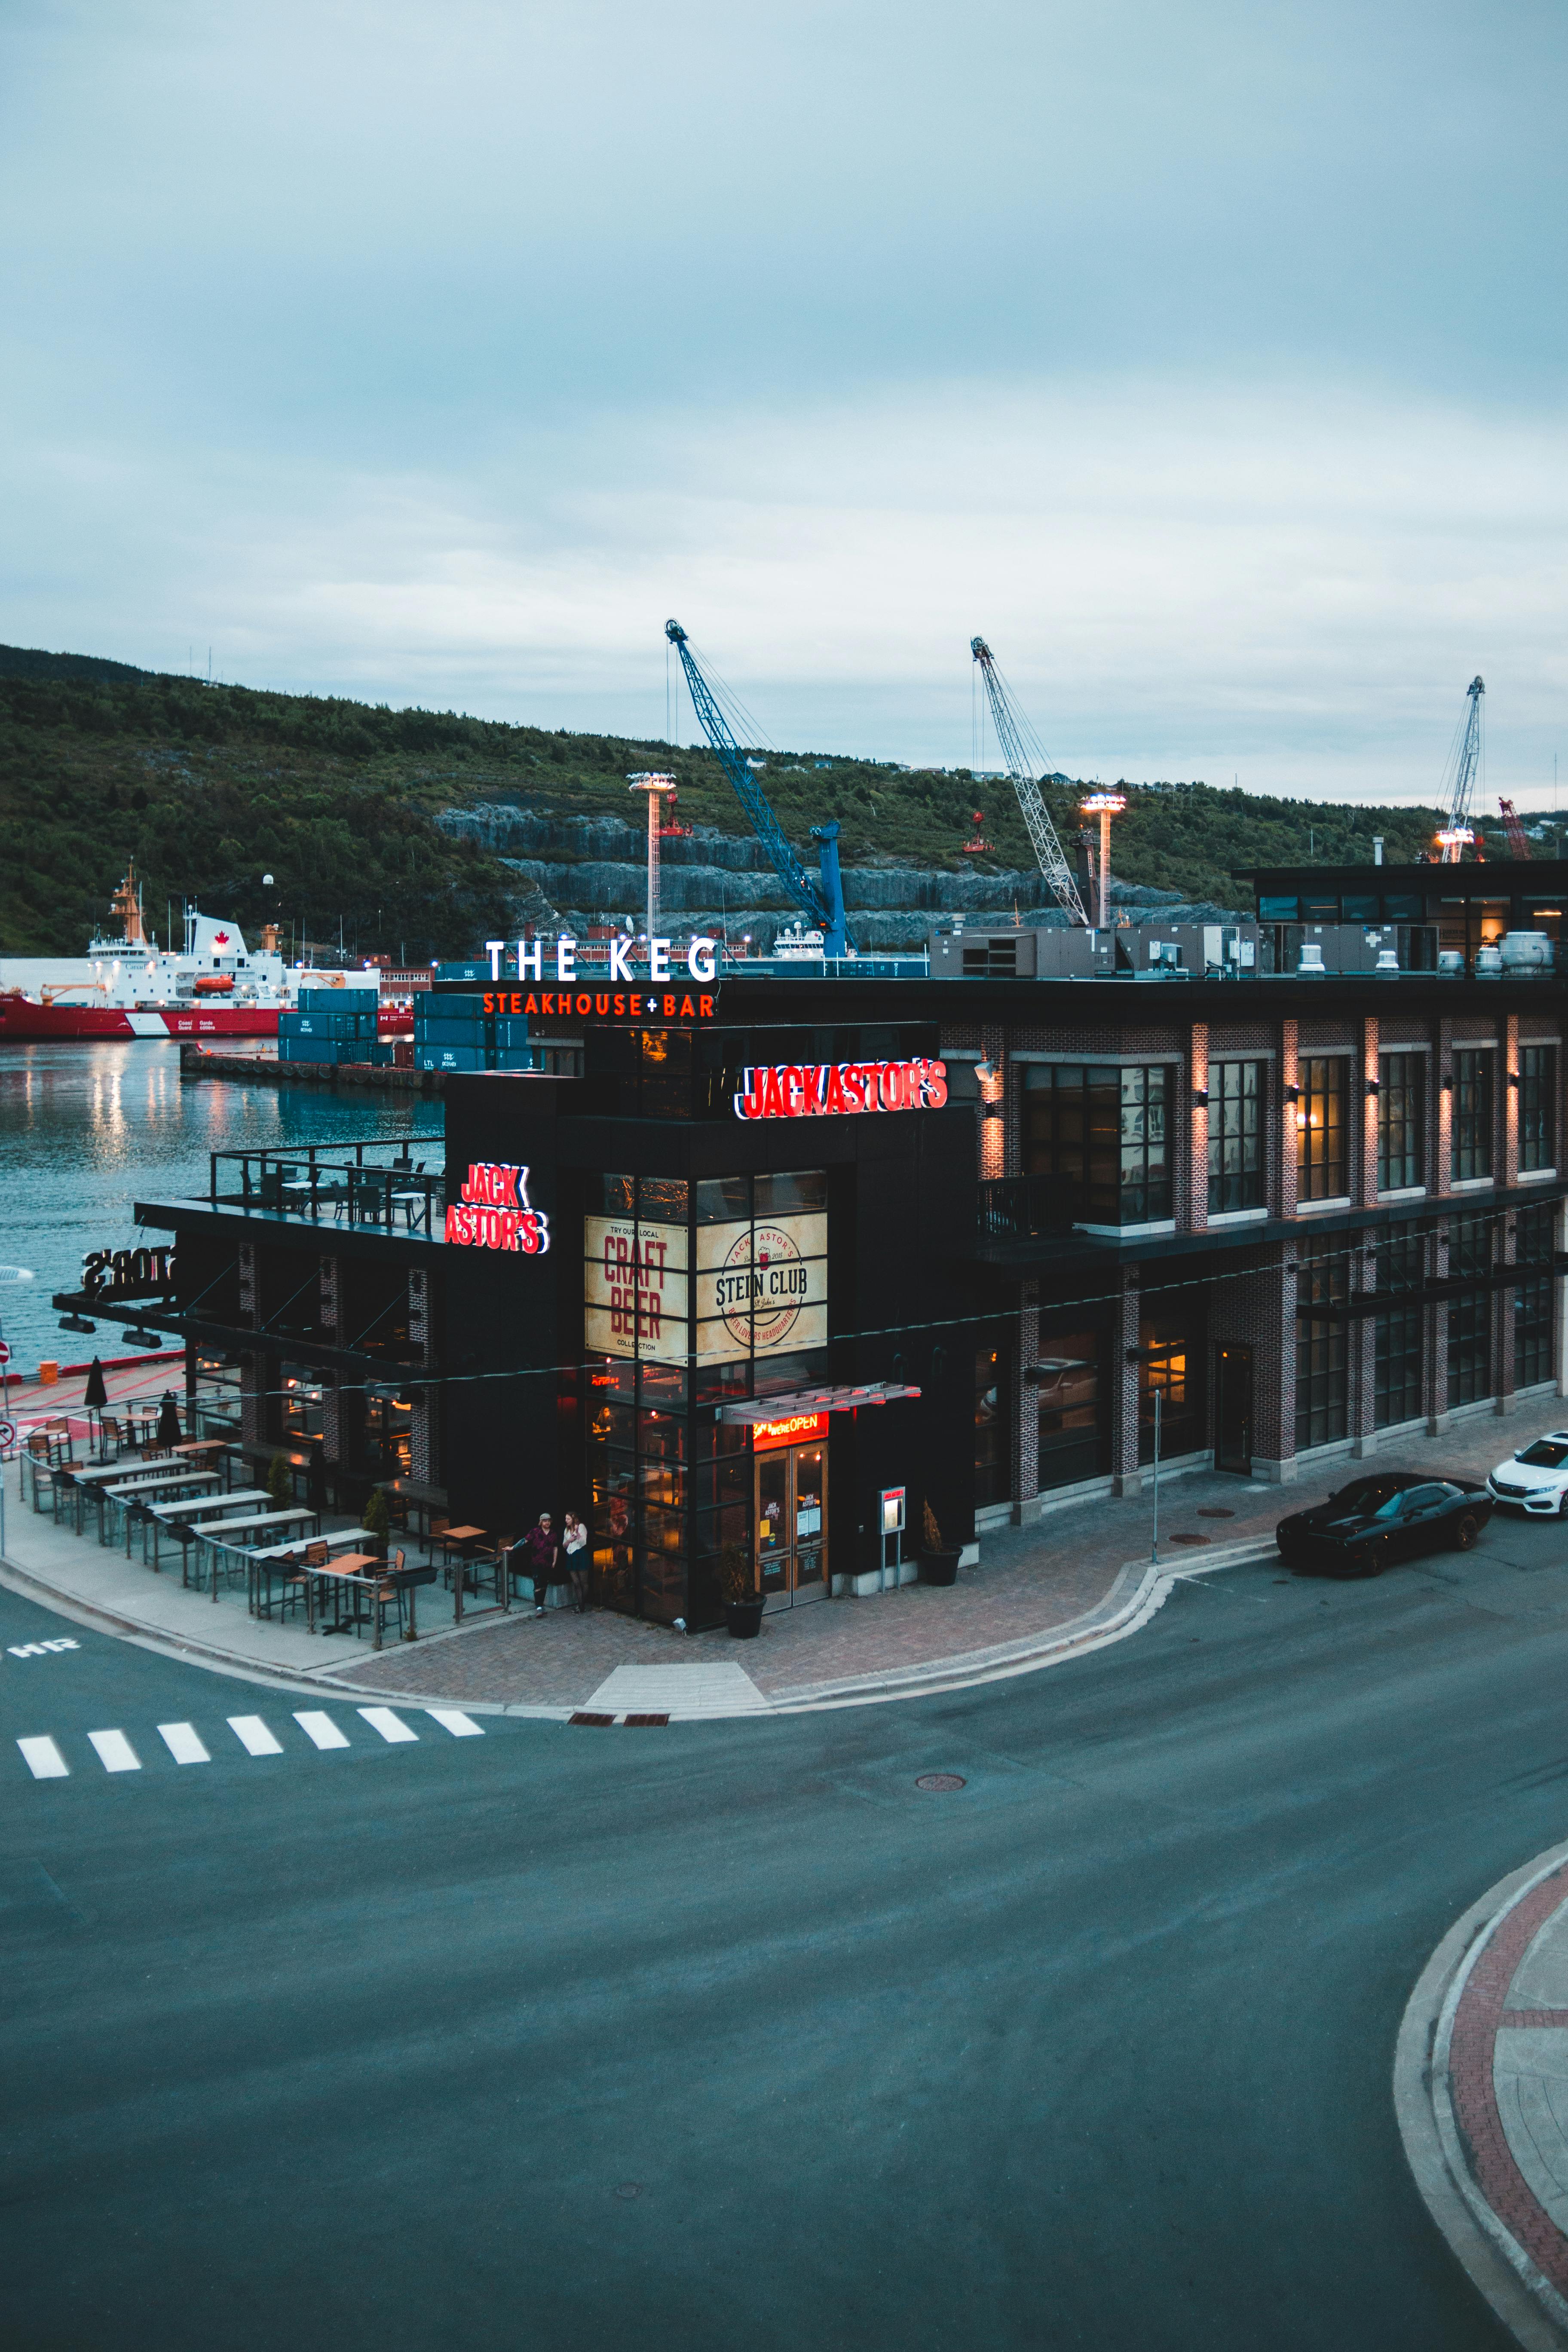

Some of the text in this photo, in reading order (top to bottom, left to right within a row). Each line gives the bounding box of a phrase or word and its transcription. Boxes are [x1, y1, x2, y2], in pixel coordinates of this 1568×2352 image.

[486, 938, 716, 982] THE KEG
[483, 993, 642, 1016] STEAKHOUSE
[663, 994, 714, 1017] BAR
[743, 1058, 948, 1118] JACK ASTOR'S
[461, 1163, 525, 1207] JACK
[444, 1204, 542, 1254] ASTOR'S
[639, 1230, 659, 1238] LOCAL
[605, 1236, 667, 1289] CRAFT
[731, 1233, 793, 1264] JACK ASTOR'S
[716, 1268, 807, 1306] STEIN CLUB
[760, 1297, 775, 1308] John's
[611, 1286, 661, 1340] BEER
[617, 1339, 655, 1351] COLLECTION
[790, 1414, 818, 1431] OPEN
[765, 1507, 780, 1516] ASTOR'S
[802, 1499, 817, 1507] ASTOR'S
